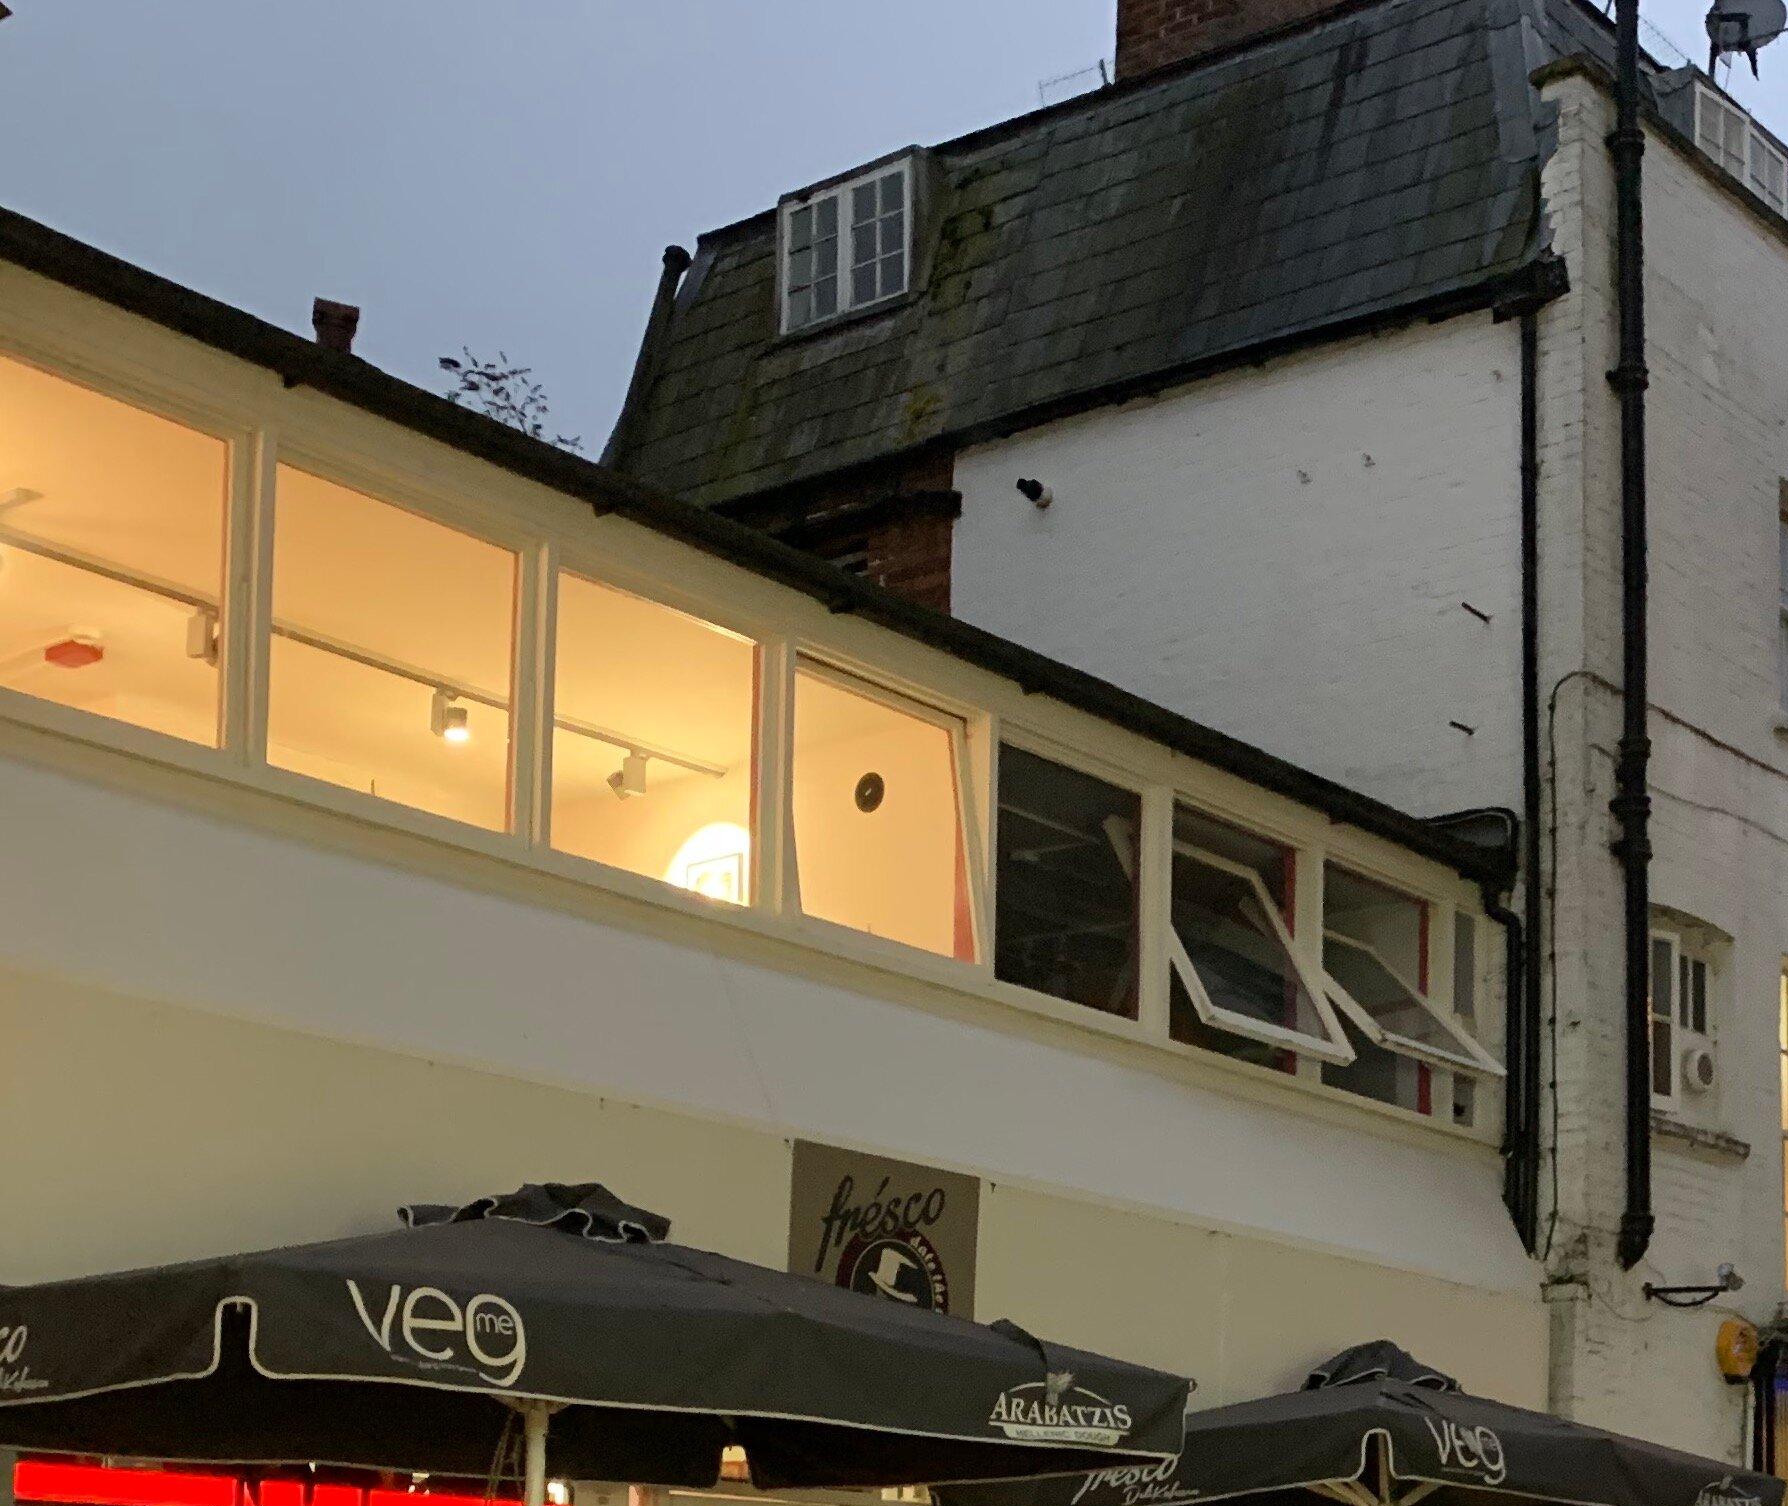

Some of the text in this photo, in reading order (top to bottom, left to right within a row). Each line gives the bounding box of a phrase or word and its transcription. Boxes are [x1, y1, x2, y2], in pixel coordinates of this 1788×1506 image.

[346, 1278, 527, 1388] veg
[475, 1312, 515, 1335] me
[989, 1391, 1132, 1429] ARABATZIS
